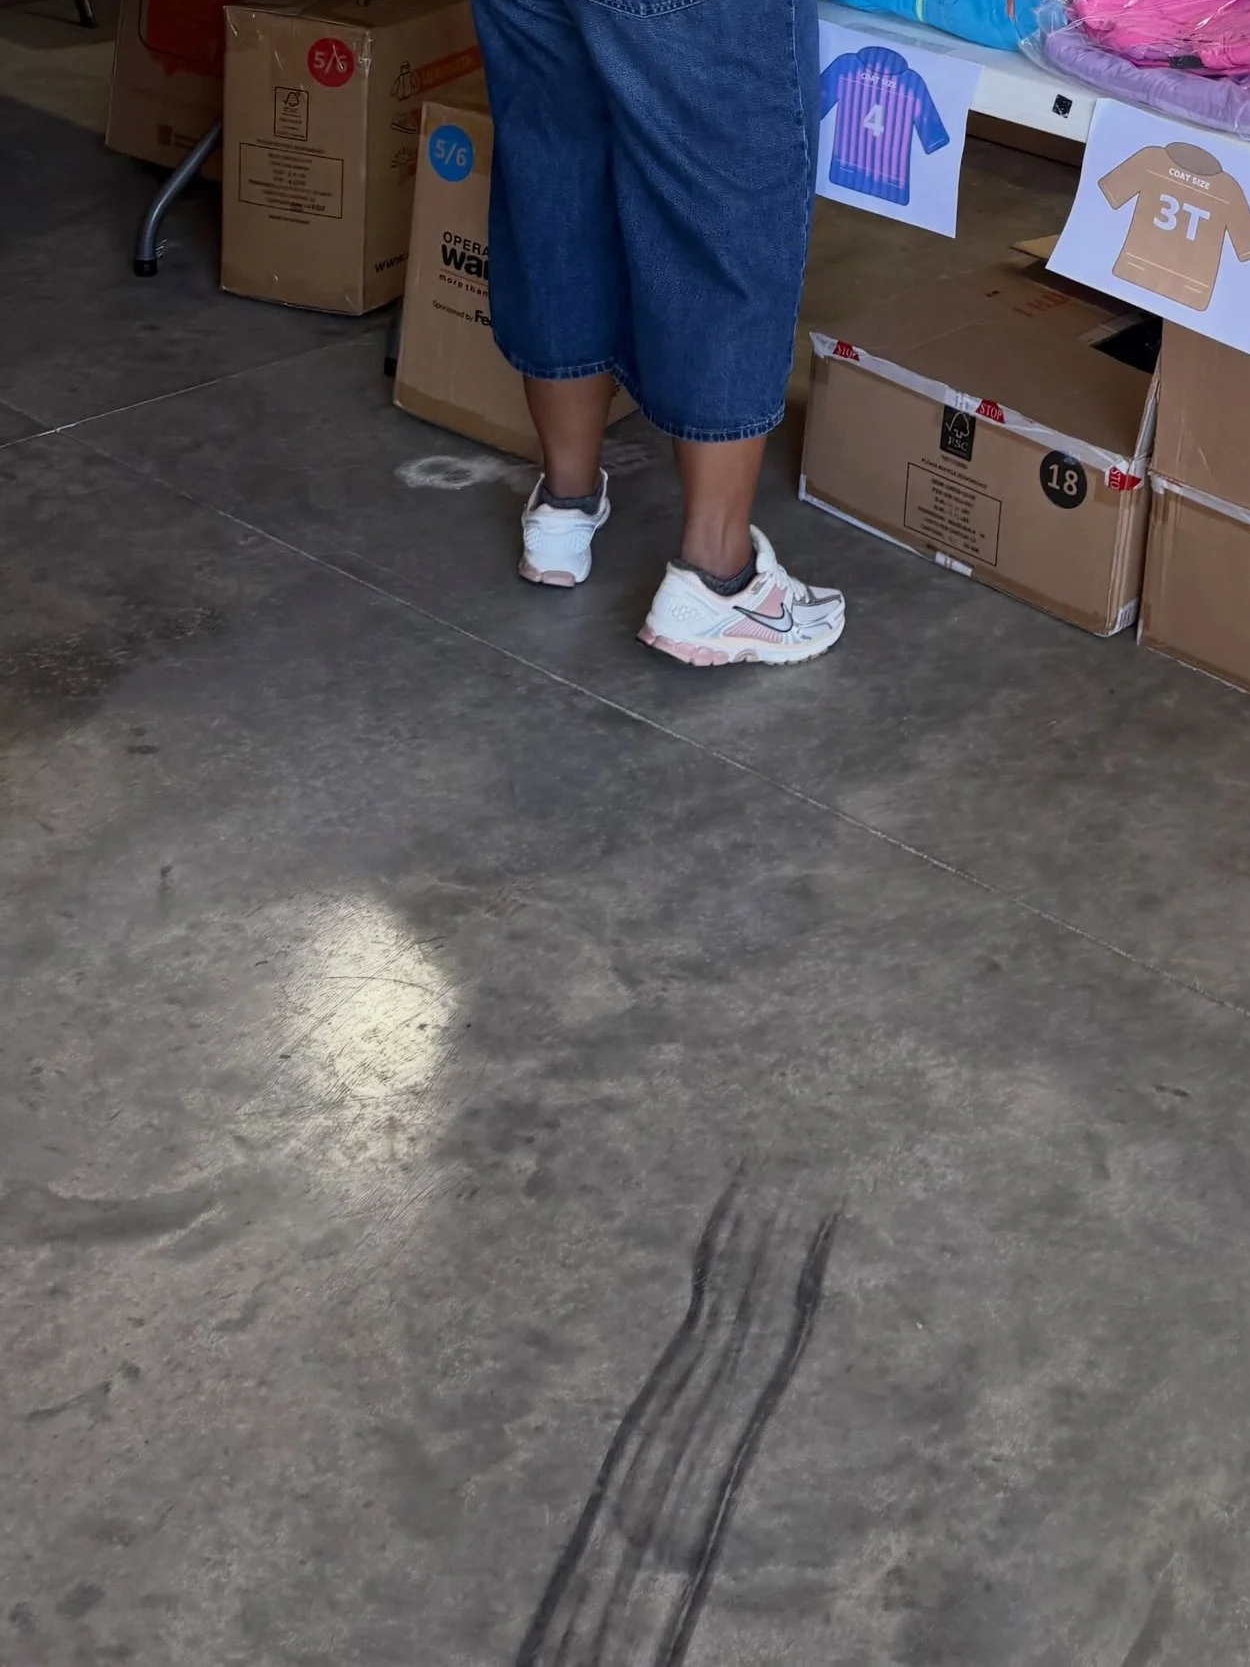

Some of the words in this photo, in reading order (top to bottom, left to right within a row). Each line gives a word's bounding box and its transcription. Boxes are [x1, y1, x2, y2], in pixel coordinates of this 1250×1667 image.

[313, 51, 347, 75] 5/6
[861, 73, 880, 84] COAT
[863, 104, 884, 137] 4
[435, 139, 467, 167] 5/6
[1168, 167, 1191, 182] COAT
[1192, 177, 1210, 190] SIZE
[1153, 194, 1210, 242] 3T
[474, 309, 492, 328] Fe
[979, 404, 1004, 421] STOP
[947, 436, 969, 452] FSC
[1047, 464, 1079, 496] 18
[1110, 467, 1121, 490] STO
